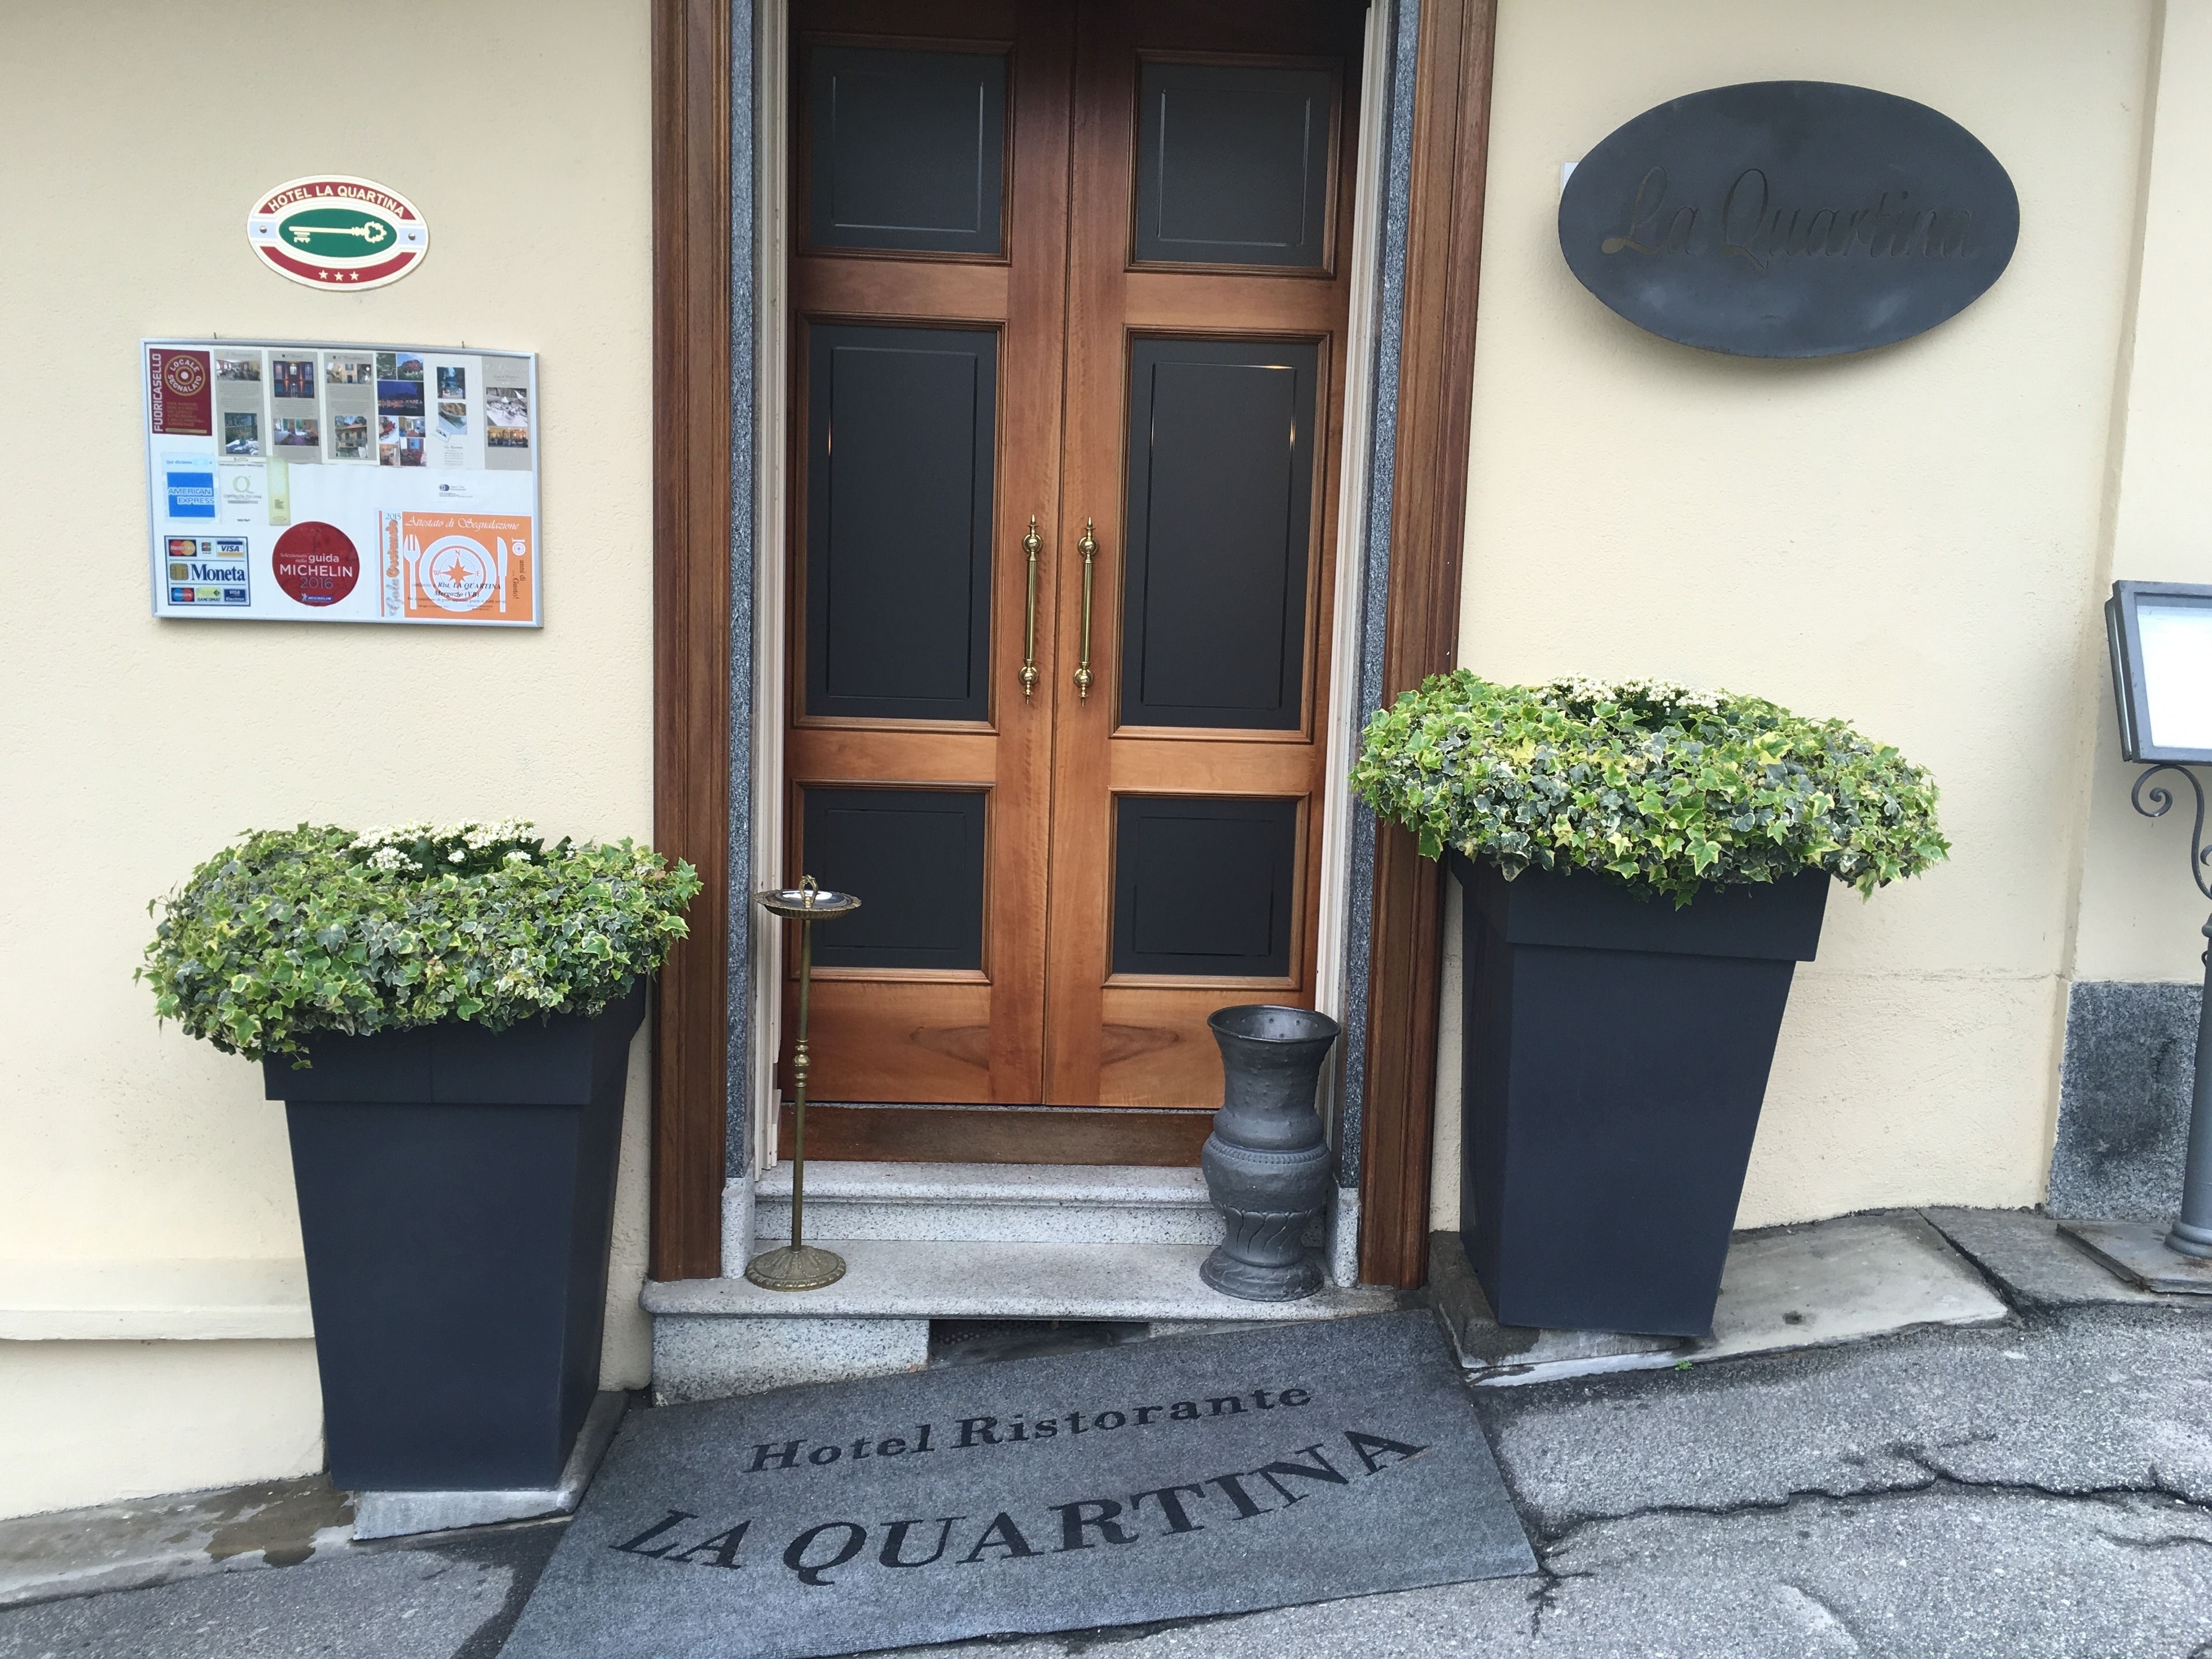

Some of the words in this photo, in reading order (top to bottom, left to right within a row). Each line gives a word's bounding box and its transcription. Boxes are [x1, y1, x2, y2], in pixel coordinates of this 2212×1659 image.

[267, 187, 313, 213] HOTEL
[315, 185, 334, 196] LA
[337, 185, 404, 218] QUARTINA
[1601, 165, 1701, 256] La
[1722, 168, 1976, 271] Quartina
[169, 359, 200, 373] LOCALE
[168, 374, 202, 392] SEGNALATO
[151, 353, 164, 433] FUORICASELLO
[385, 513, 402, 521] 2015
[405, 516, 444, 528] Attestato
[445, 518, 454, 528] di
[457, 517, 520, 532] Segnalazione
[308, 553, 339, 563] guida
[191, 563, 246, 581] Moneta
[279, 564, 353, 577] MICHELIN
[300, 576, 334, 589] 2016
[745, 1424, 935, 1474] Hotel
[952, 1387, 1313, 1449] Ristorante
[609, 1509, 753, 1570] LA
[782, 1429, 1431, 1586] QUARTINA
